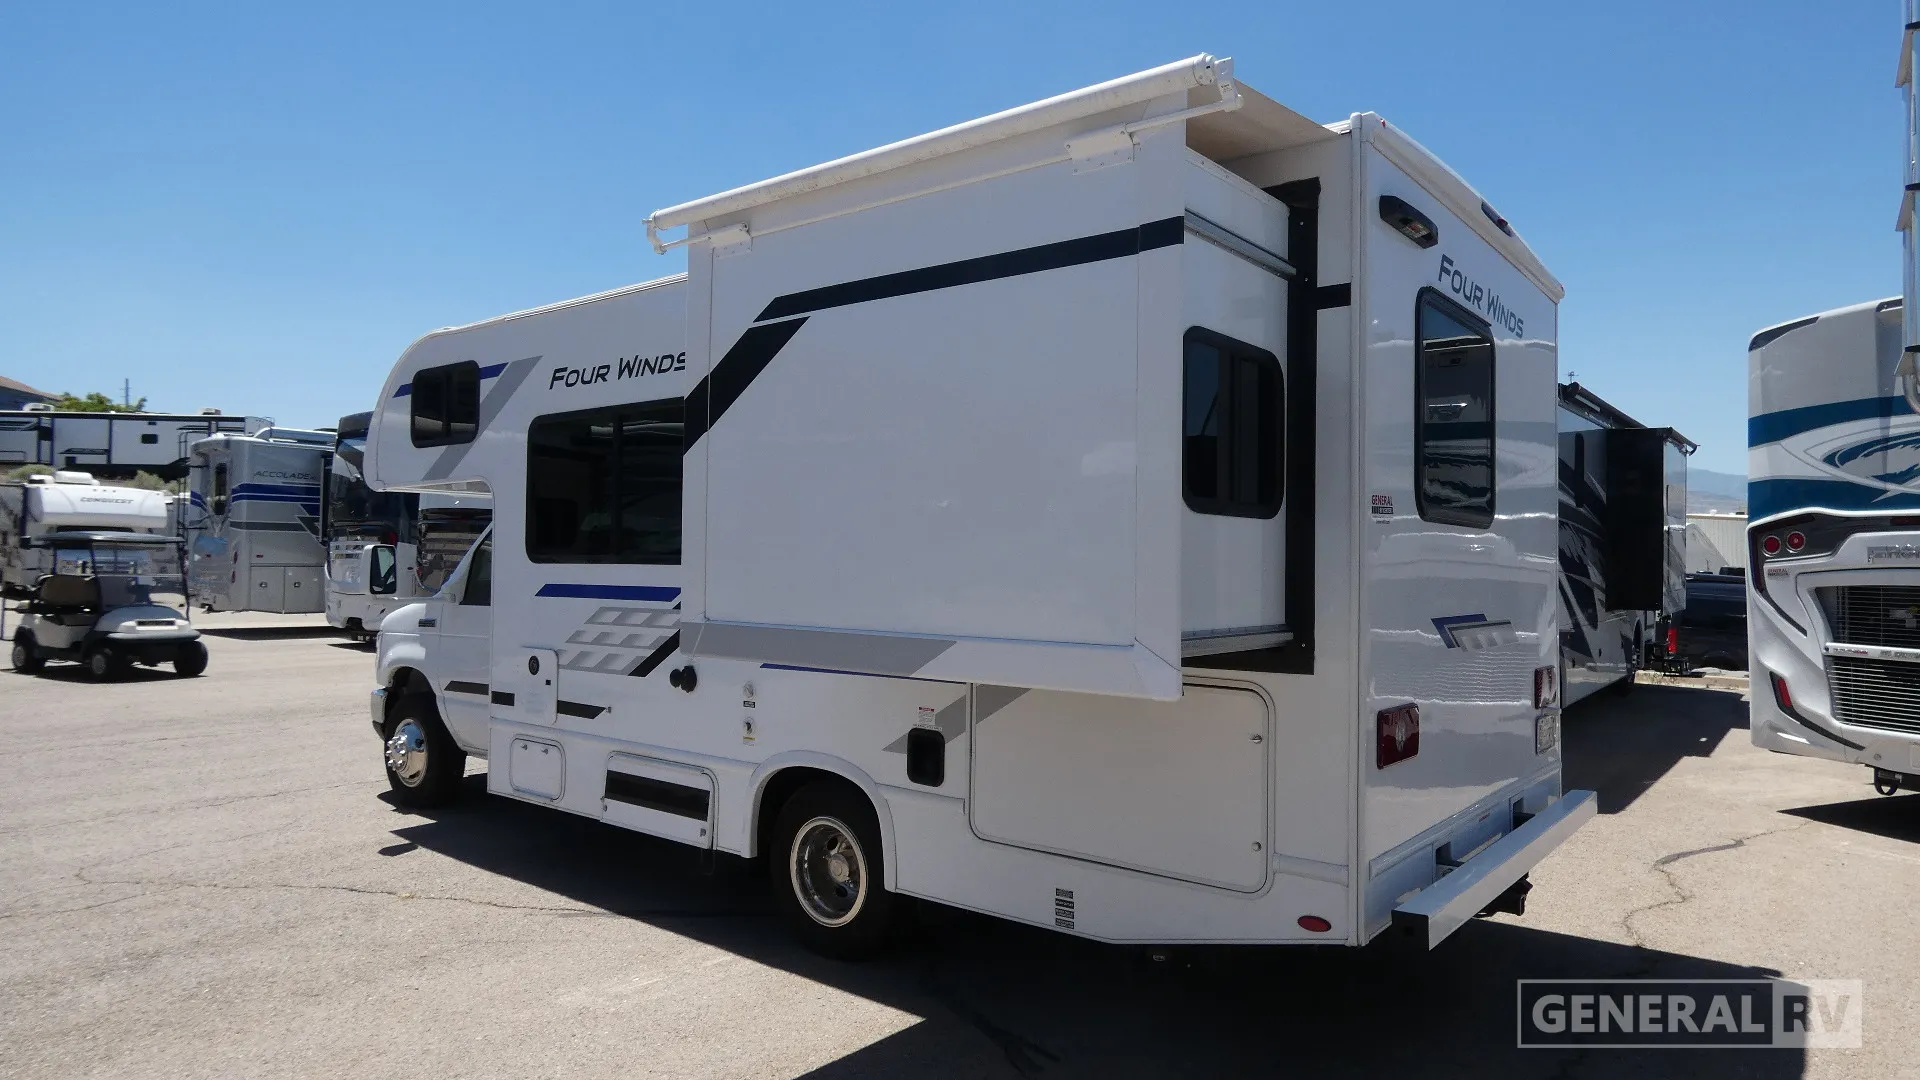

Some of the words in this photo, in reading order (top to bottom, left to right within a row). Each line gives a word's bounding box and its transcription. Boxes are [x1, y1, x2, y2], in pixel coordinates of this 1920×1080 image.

[1438, 253, 1484, 311] FOUR
[1487, 288, 1524, 339] WINDS
[549, 364, 611, 391] FOUR
[253, 469, 311, 480] ACCOLADE
[1371, 494, 1393, 506] GENERAL
